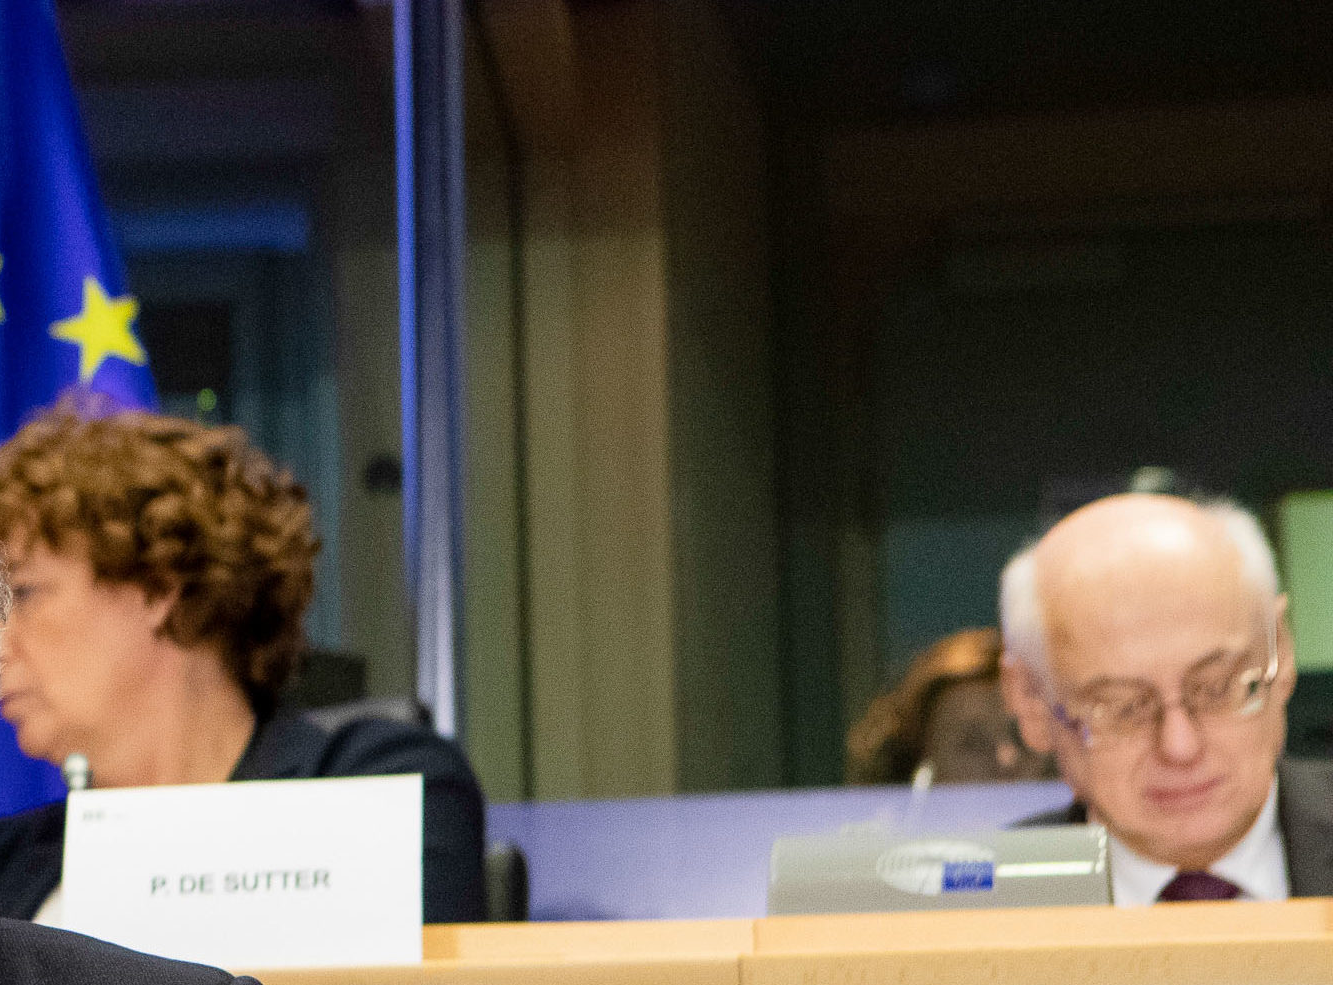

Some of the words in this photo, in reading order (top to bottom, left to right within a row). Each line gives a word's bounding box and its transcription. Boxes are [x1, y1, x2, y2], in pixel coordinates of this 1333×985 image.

[150, 875, 169, 895] P.
[179, 873, 214, 894] DE
[224, 868, 331, 892] SUTTER
